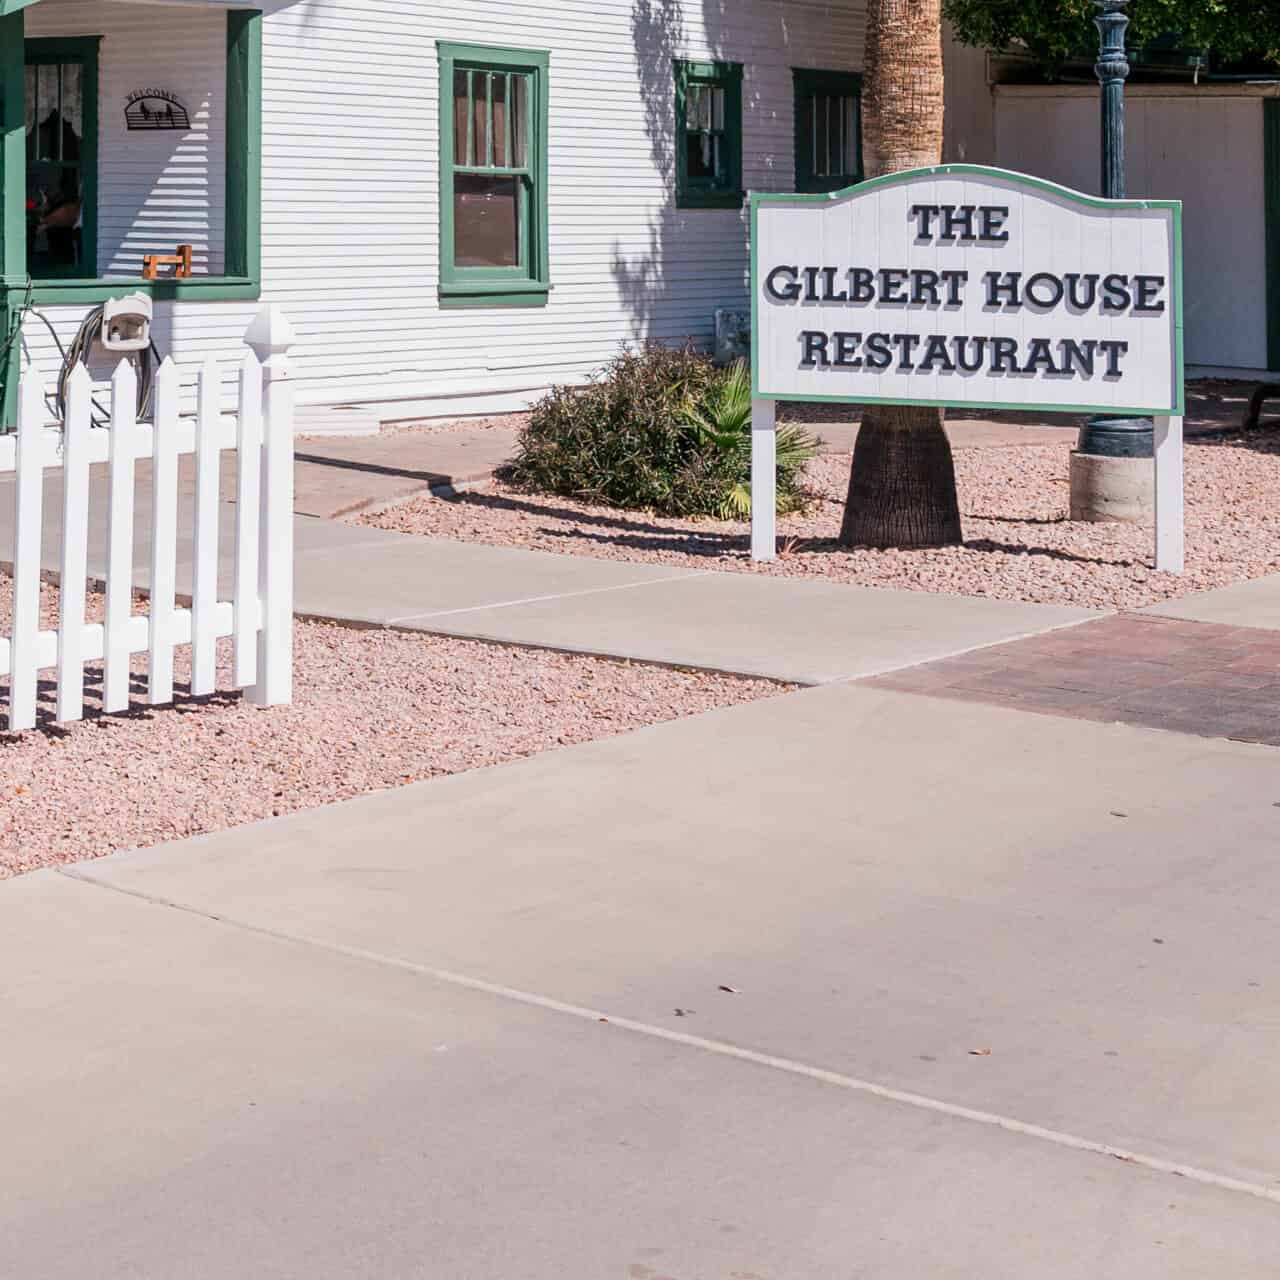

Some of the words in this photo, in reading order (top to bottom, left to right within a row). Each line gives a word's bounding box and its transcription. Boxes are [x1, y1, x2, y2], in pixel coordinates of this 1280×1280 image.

[126, 87, 178, 102] WELCOME
[912, 204, 1009, 242] THE
[765, 265, 969, 307] GILBERT
[984, 270, 1166, 313] HOUSE
[801, 330, 1129, 377] RESTAURANT
